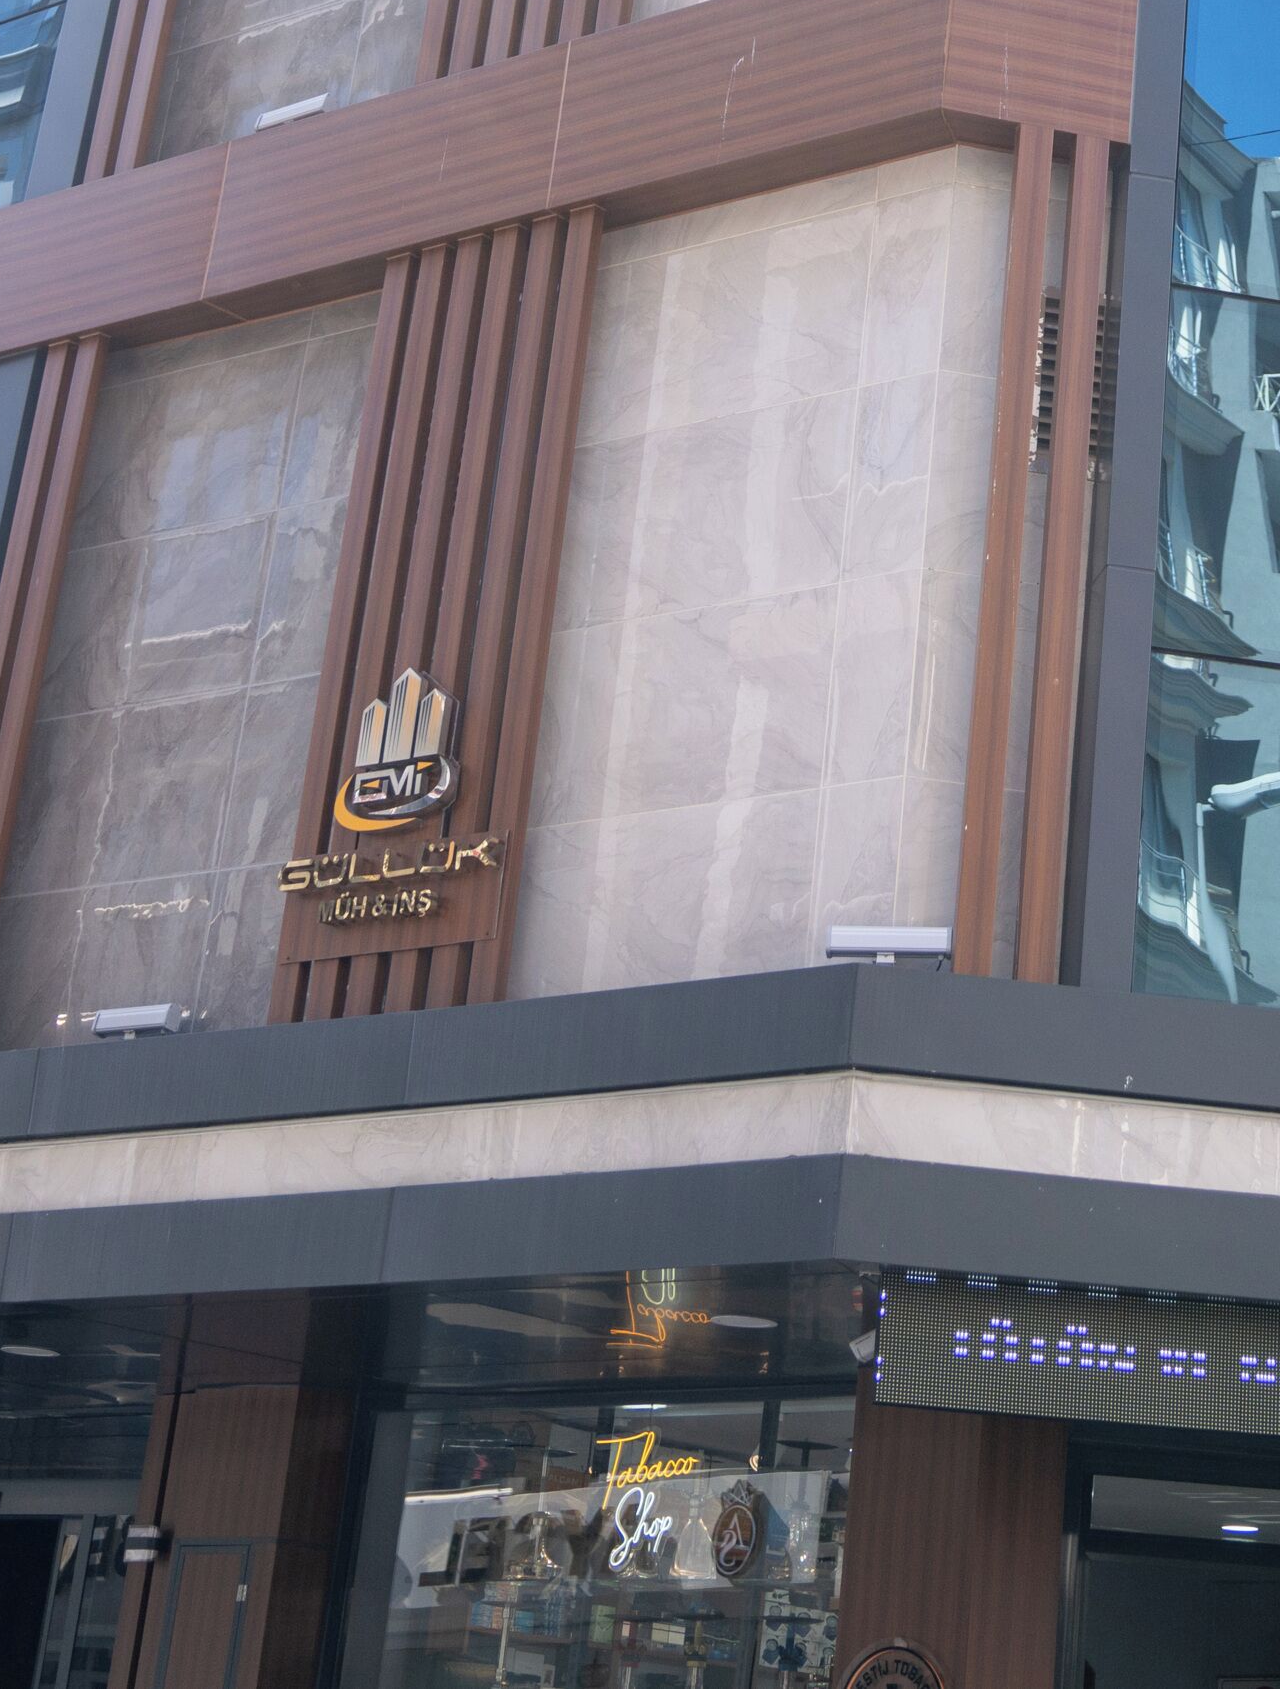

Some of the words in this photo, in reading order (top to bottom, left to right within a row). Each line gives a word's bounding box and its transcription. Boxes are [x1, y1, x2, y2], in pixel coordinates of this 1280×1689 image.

[320, 891, 368, 924] MÜH
[371, 893, 388, 917] &
[596, 1430, 701, 1511] Tabacco
[609, 1486, 674, 1568] Shop
